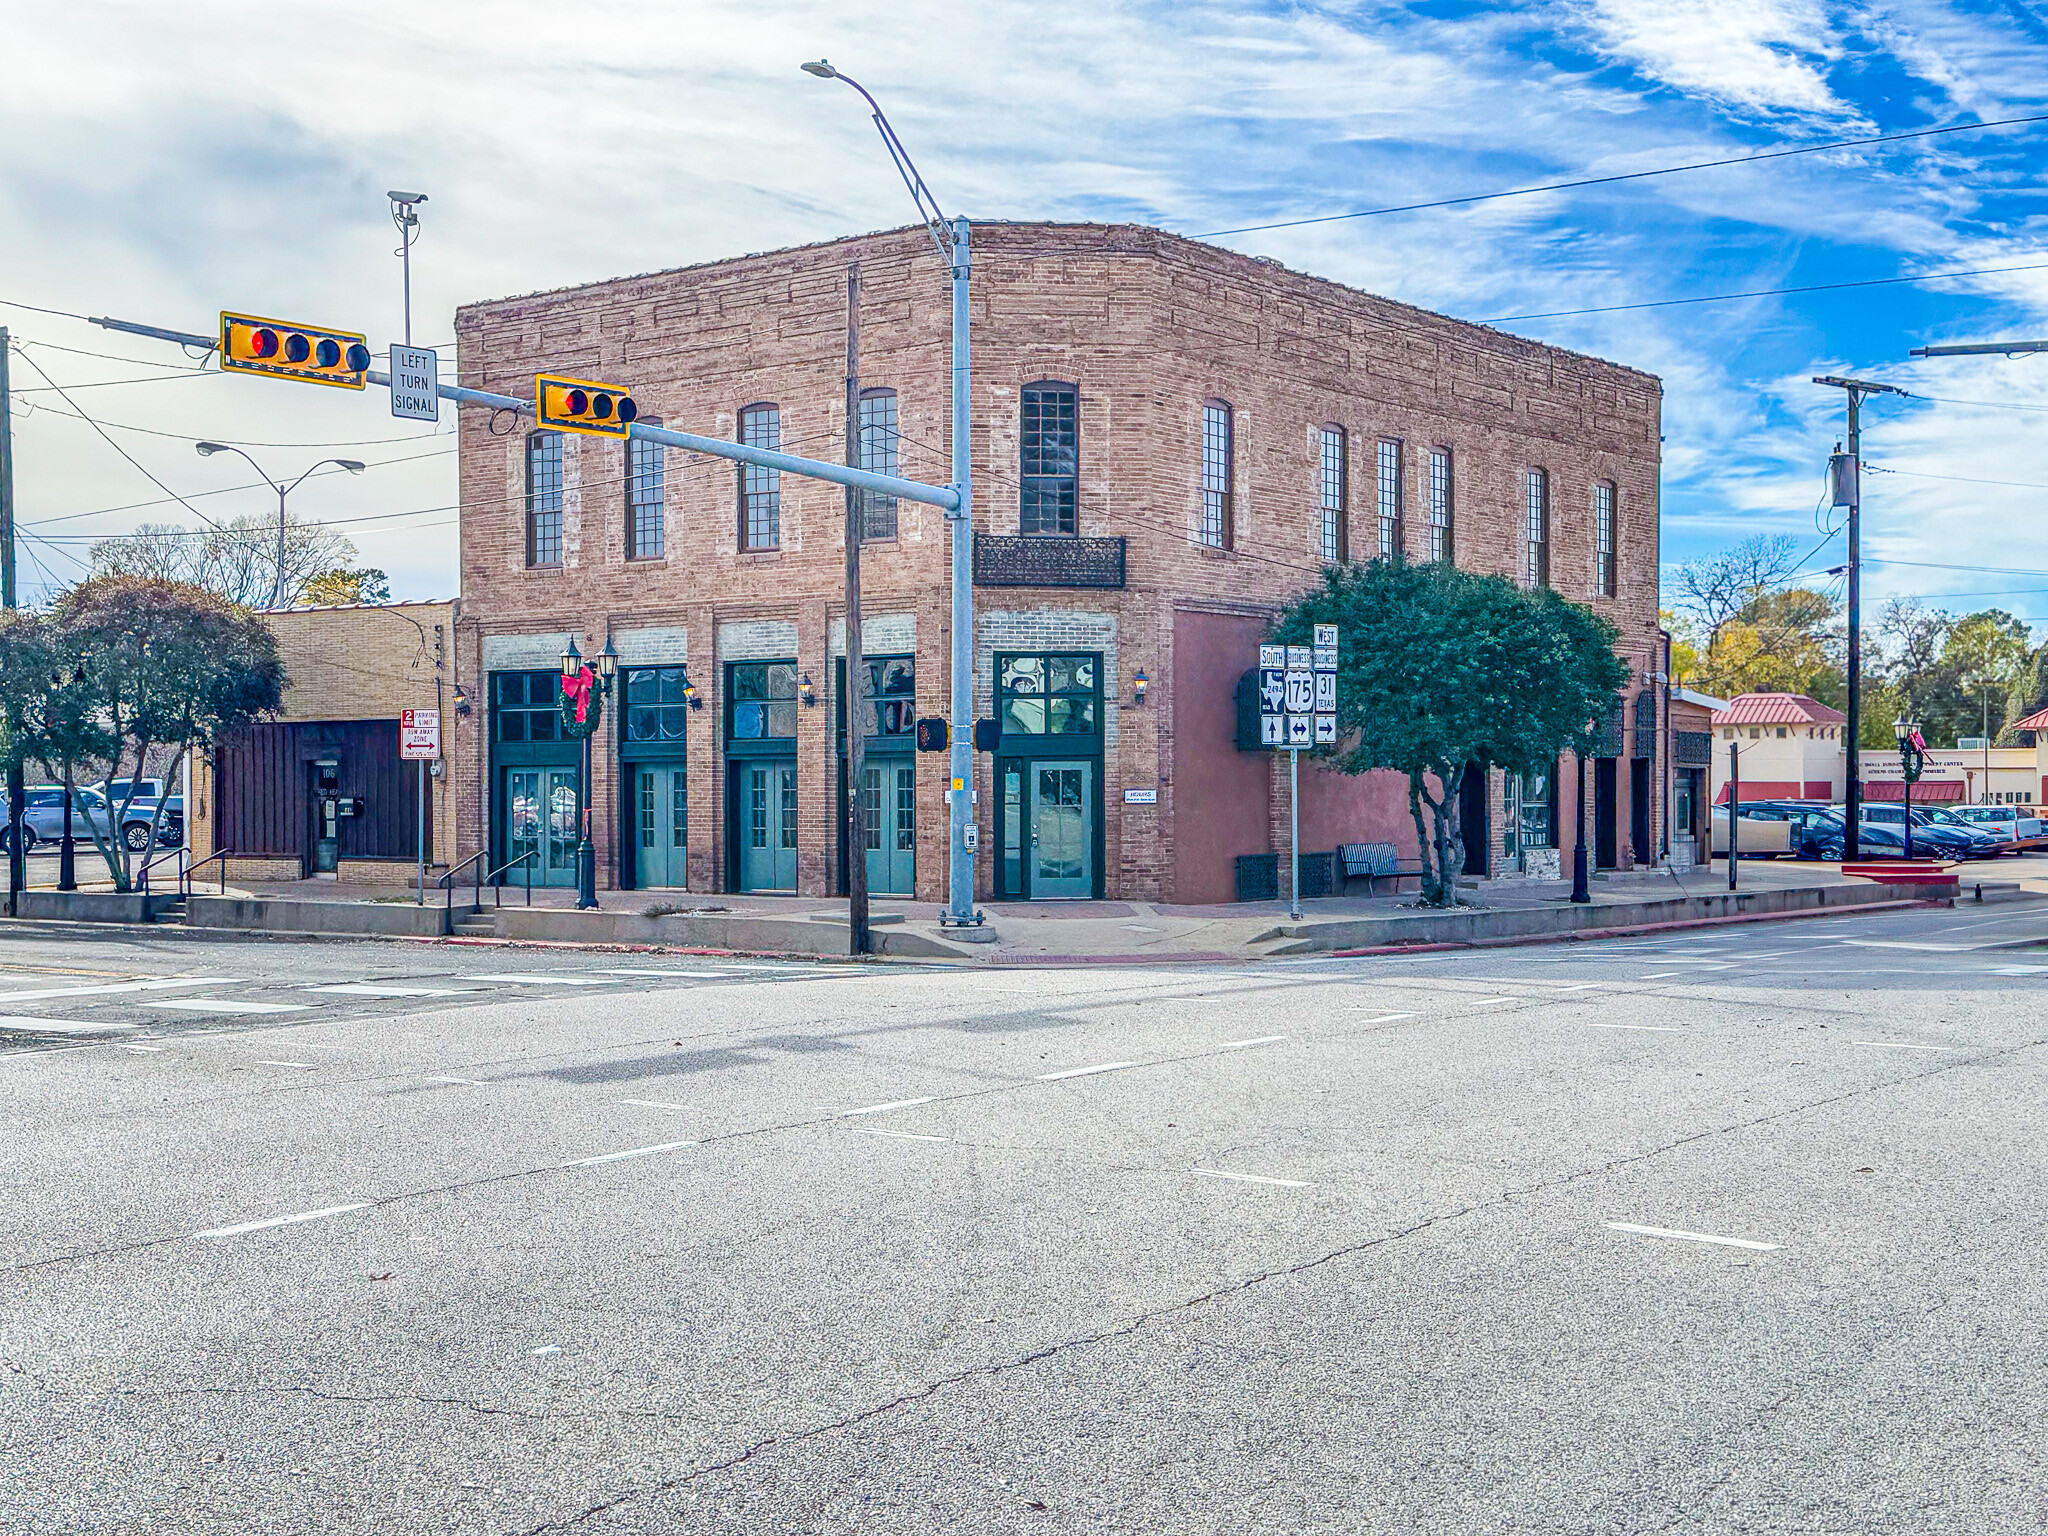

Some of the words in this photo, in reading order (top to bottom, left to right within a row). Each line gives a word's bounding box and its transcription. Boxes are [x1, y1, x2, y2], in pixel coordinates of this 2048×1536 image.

[401, 353, 427, 369] LEFT
[400, 374, 428, 390] TURN
[395, 394, 434, 412] SIGNAL
[1318, 628, 1334, 644] WEST
[1262, 649, 1283, 665] SOUTH
[1288, 652, 1310, 664] BUSINESS
[1314, 653, 1337, 665] BUSINESS
[1267, 685, 1283, 693] 2494
[1288, 680, 1311, 703] 175
[1320, 677, 1331, 695] 31
[1318, 699, 1334, 707] TEXAS
[405, 711, 412, 720] 2
